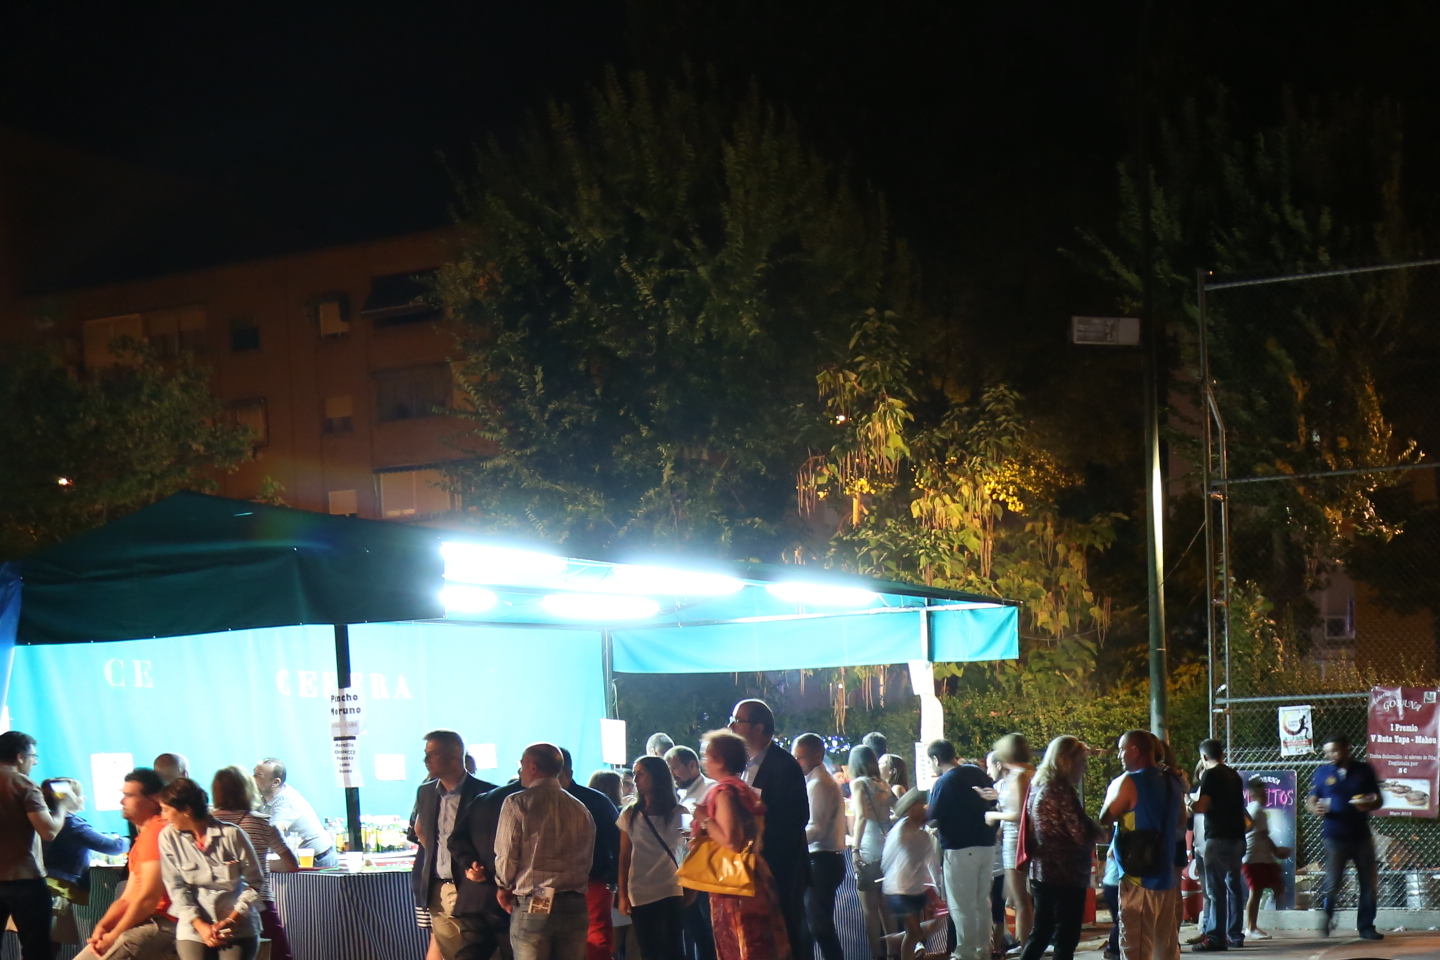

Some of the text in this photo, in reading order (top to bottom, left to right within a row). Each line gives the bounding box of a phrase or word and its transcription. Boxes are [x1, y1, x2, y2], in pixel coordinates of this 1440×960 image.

[330, 693, 358, 703] Pincho
[330, 706, 361, 716] Moruno
[1394, 723, 1419, 732] Premio
[1370, 734, 1377, 743] V
[1377, 734, 1393, 743] Ruta
[1394, 735, 1410, 745] Tapa
[1415, 735, 1437, 744] Mahou
